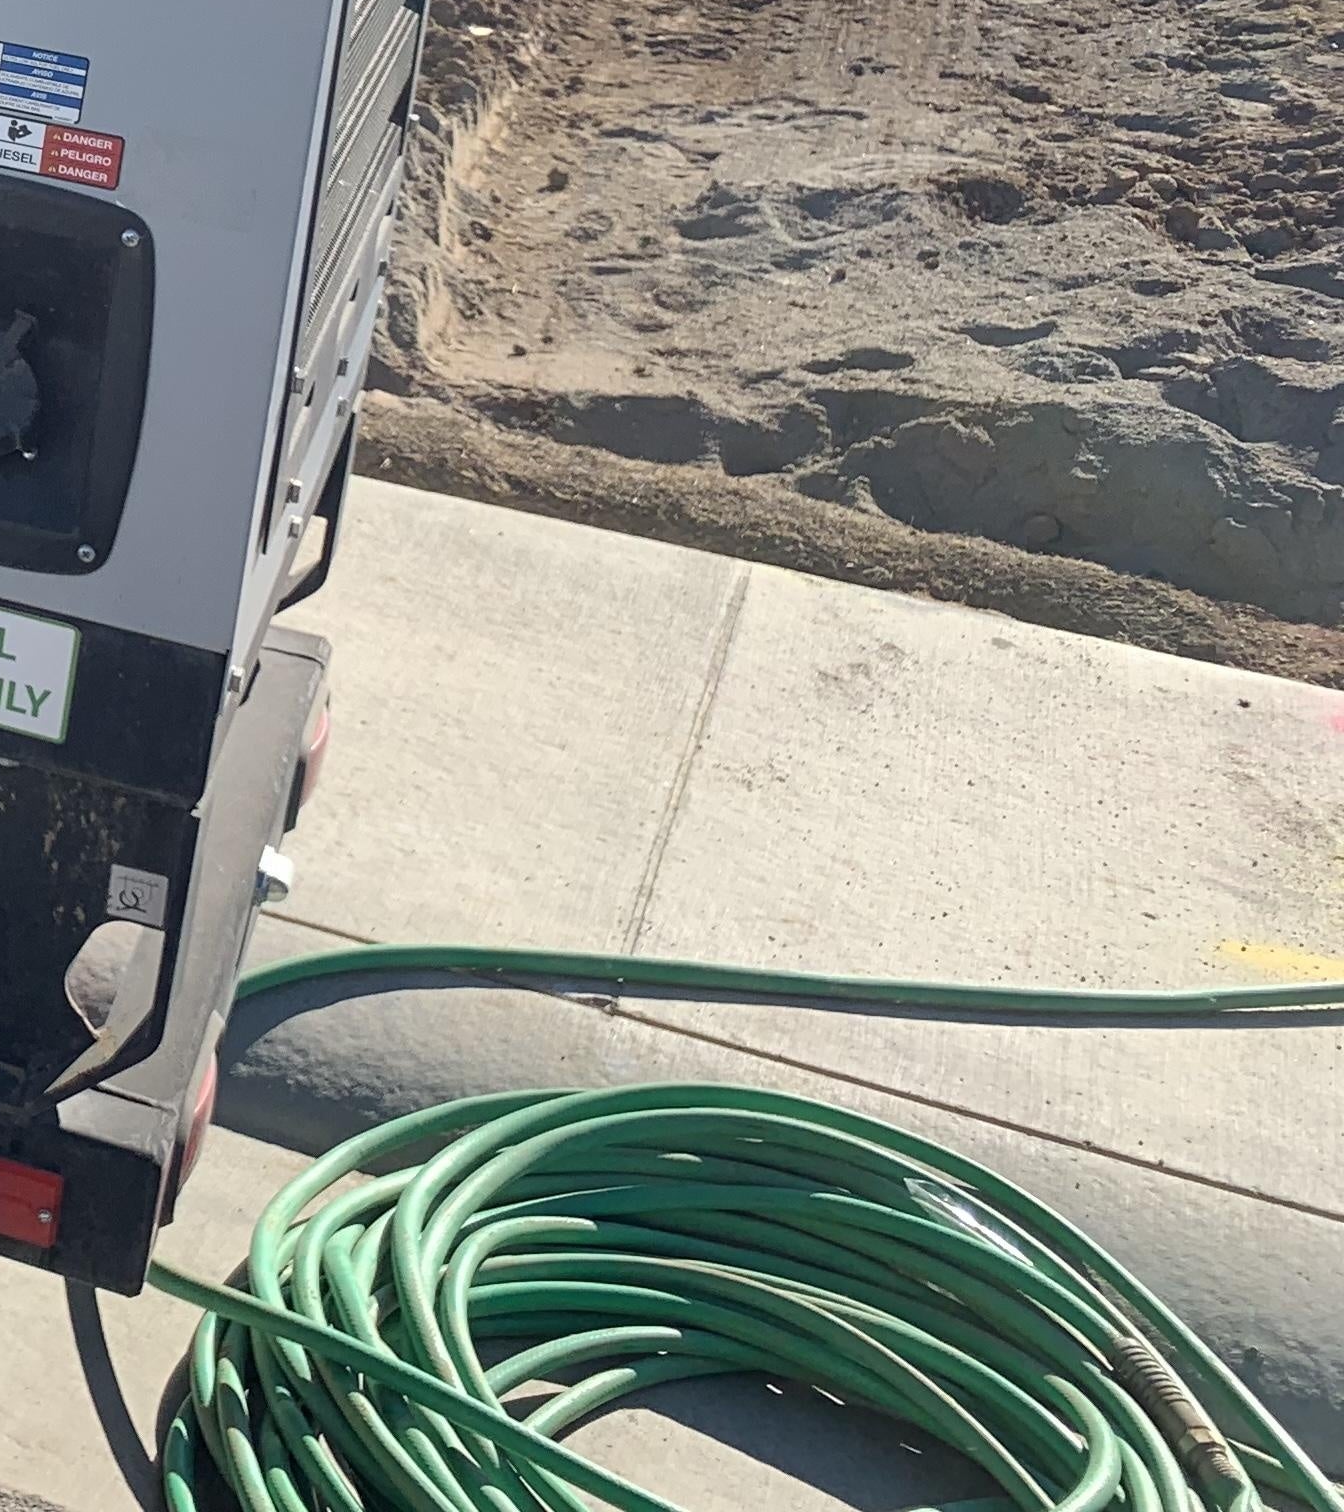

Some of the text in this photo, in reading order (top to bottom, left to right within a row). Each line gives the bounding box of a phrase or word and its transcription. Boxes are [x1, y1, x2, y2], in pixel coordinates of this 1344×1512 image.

[31, 50, 59, 63] NOTICE
[63, 131, 113, 151] DANGER
[60, 148, 112, 167] PELIGRO
[58, 164, 108, 183] DANGER
